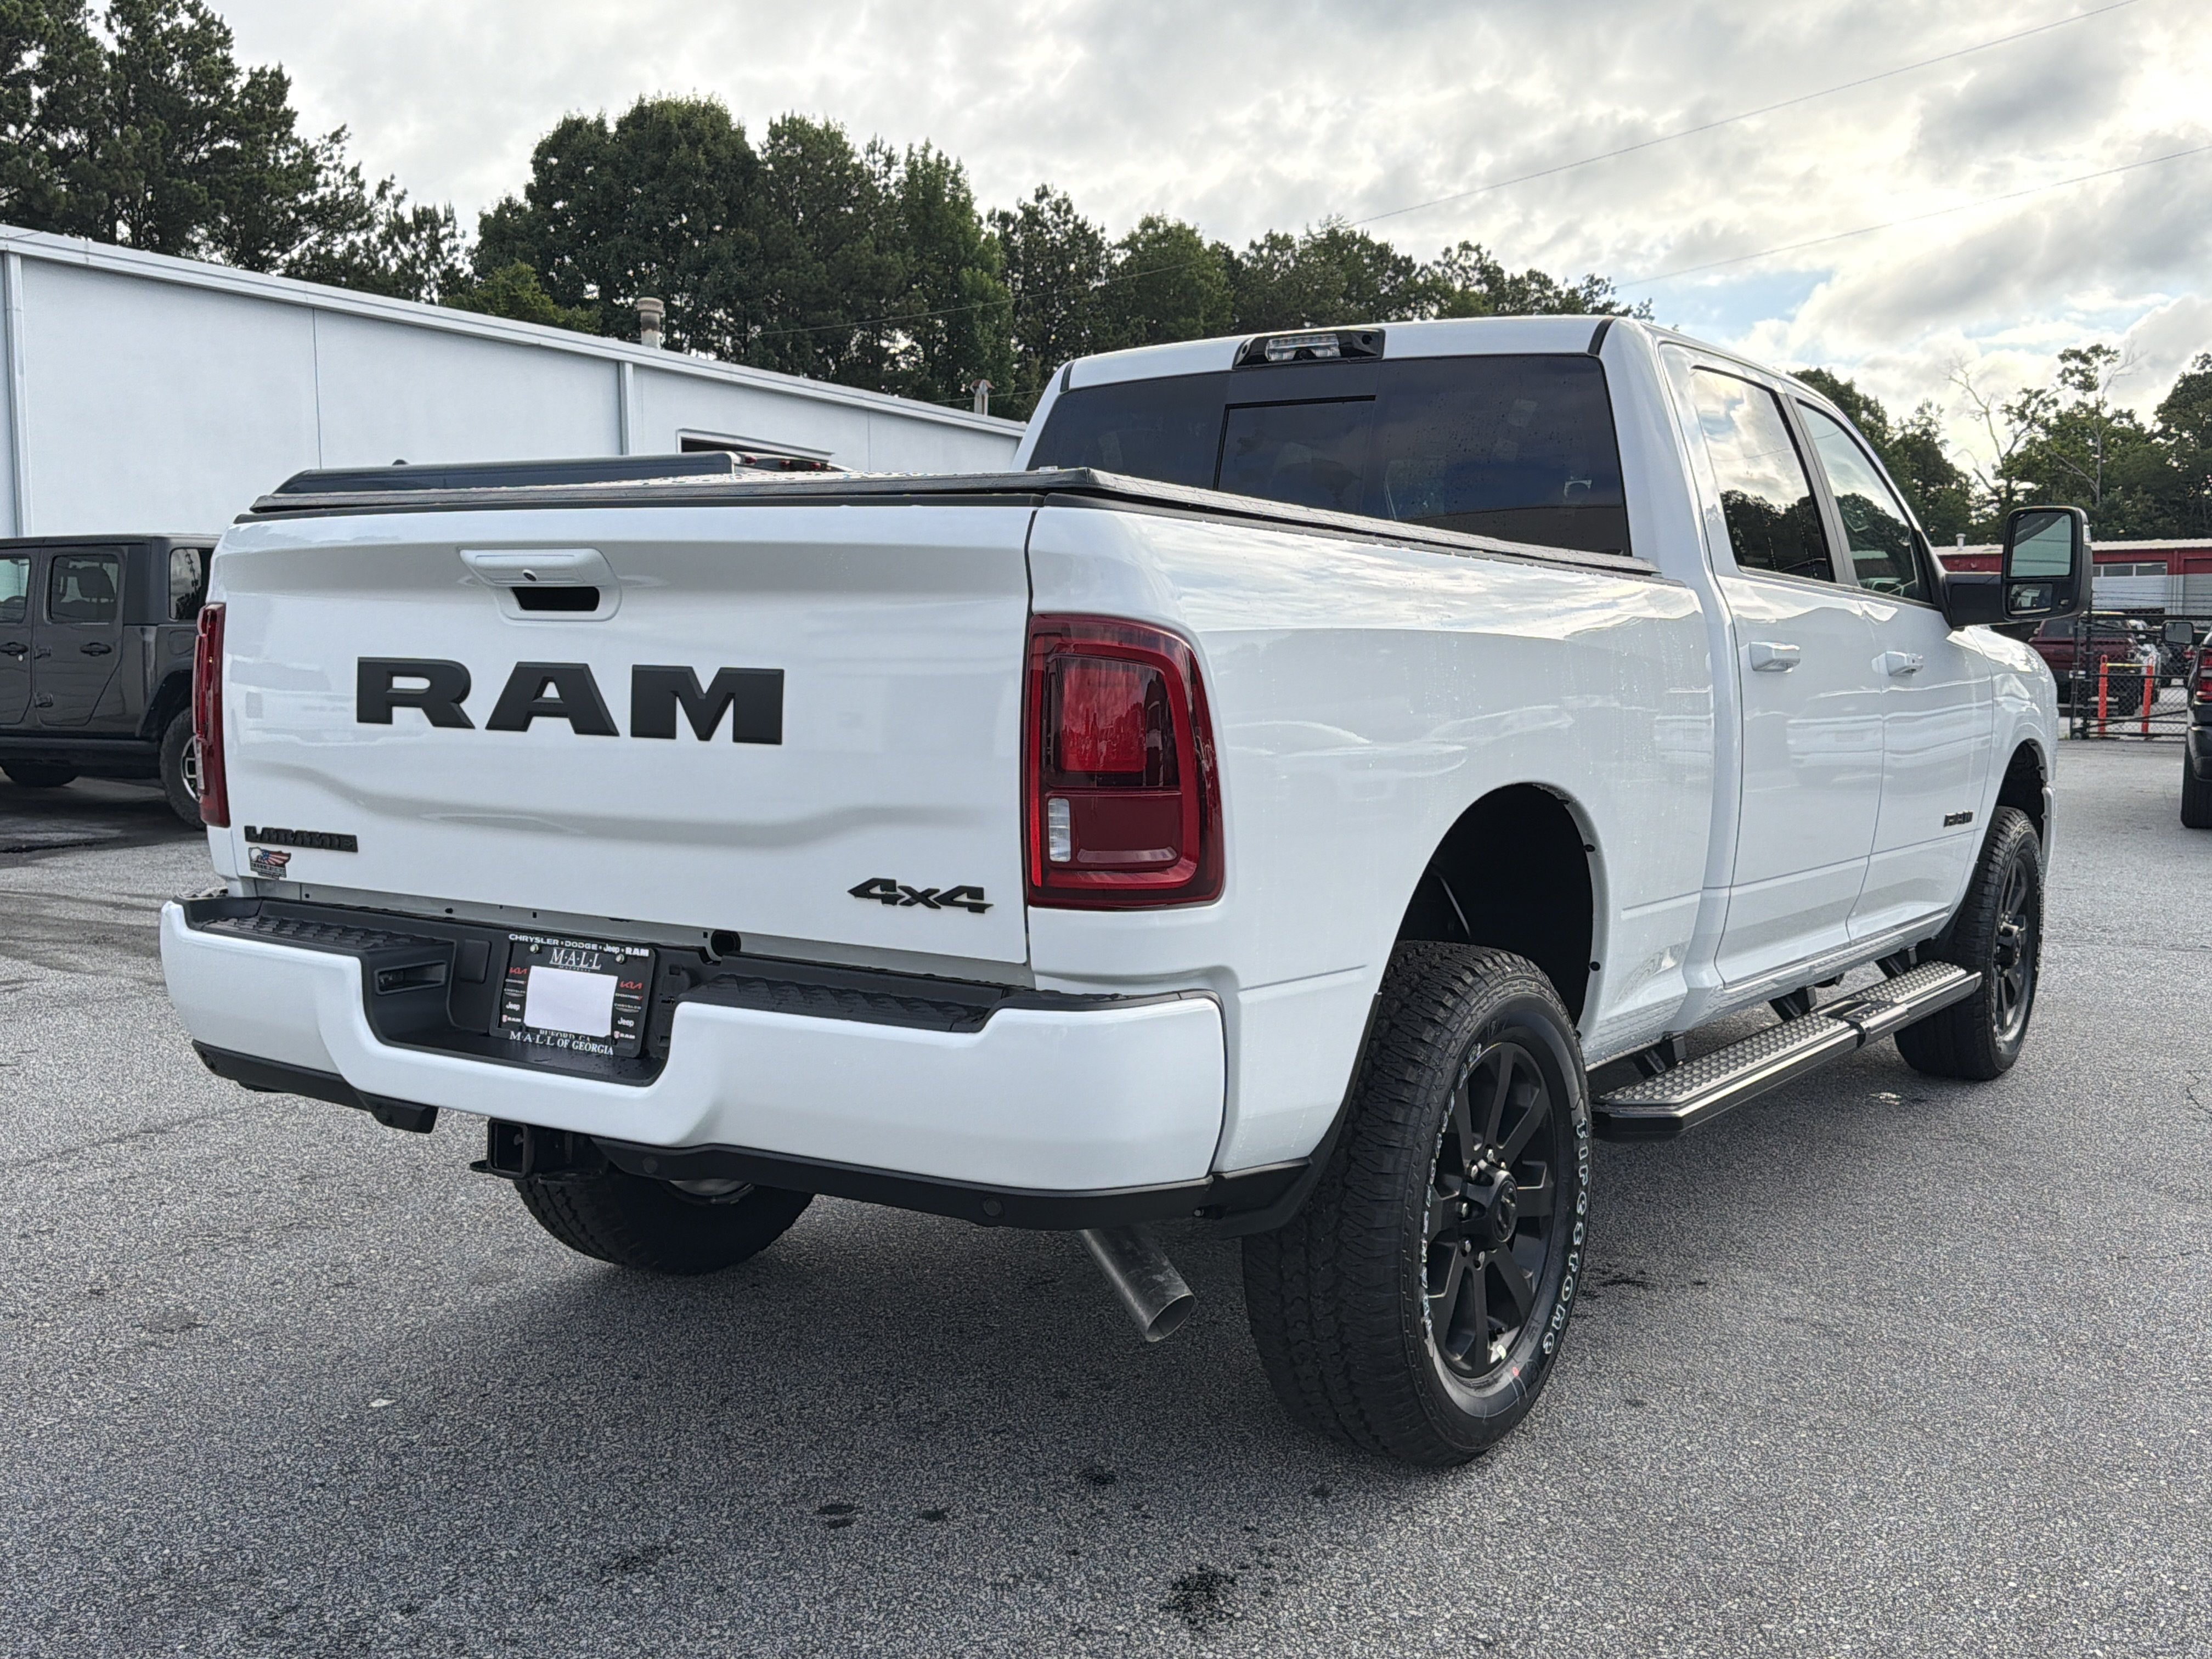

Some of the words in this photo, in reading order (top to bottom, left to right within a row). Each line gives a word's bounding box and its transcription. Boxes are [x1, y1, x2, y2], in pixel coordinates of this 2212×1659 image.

[357, 656, 785, 746] RAM
[244, 825, 359, 853] LARAMIE
[509, 933, 558, 945] CHRYSLER
[565, 940, 597, 951] DODGE
[603, 943, 620, 954] Jeep
[625, 946, 649, 957] RAM
[505, 1001, 521, 1012] Jeep
[617, 1017, 635, 1028] Jeep
[557, 1038, 570, 1048] OF
[572, 1040, 614, 1056] GEORGIA
